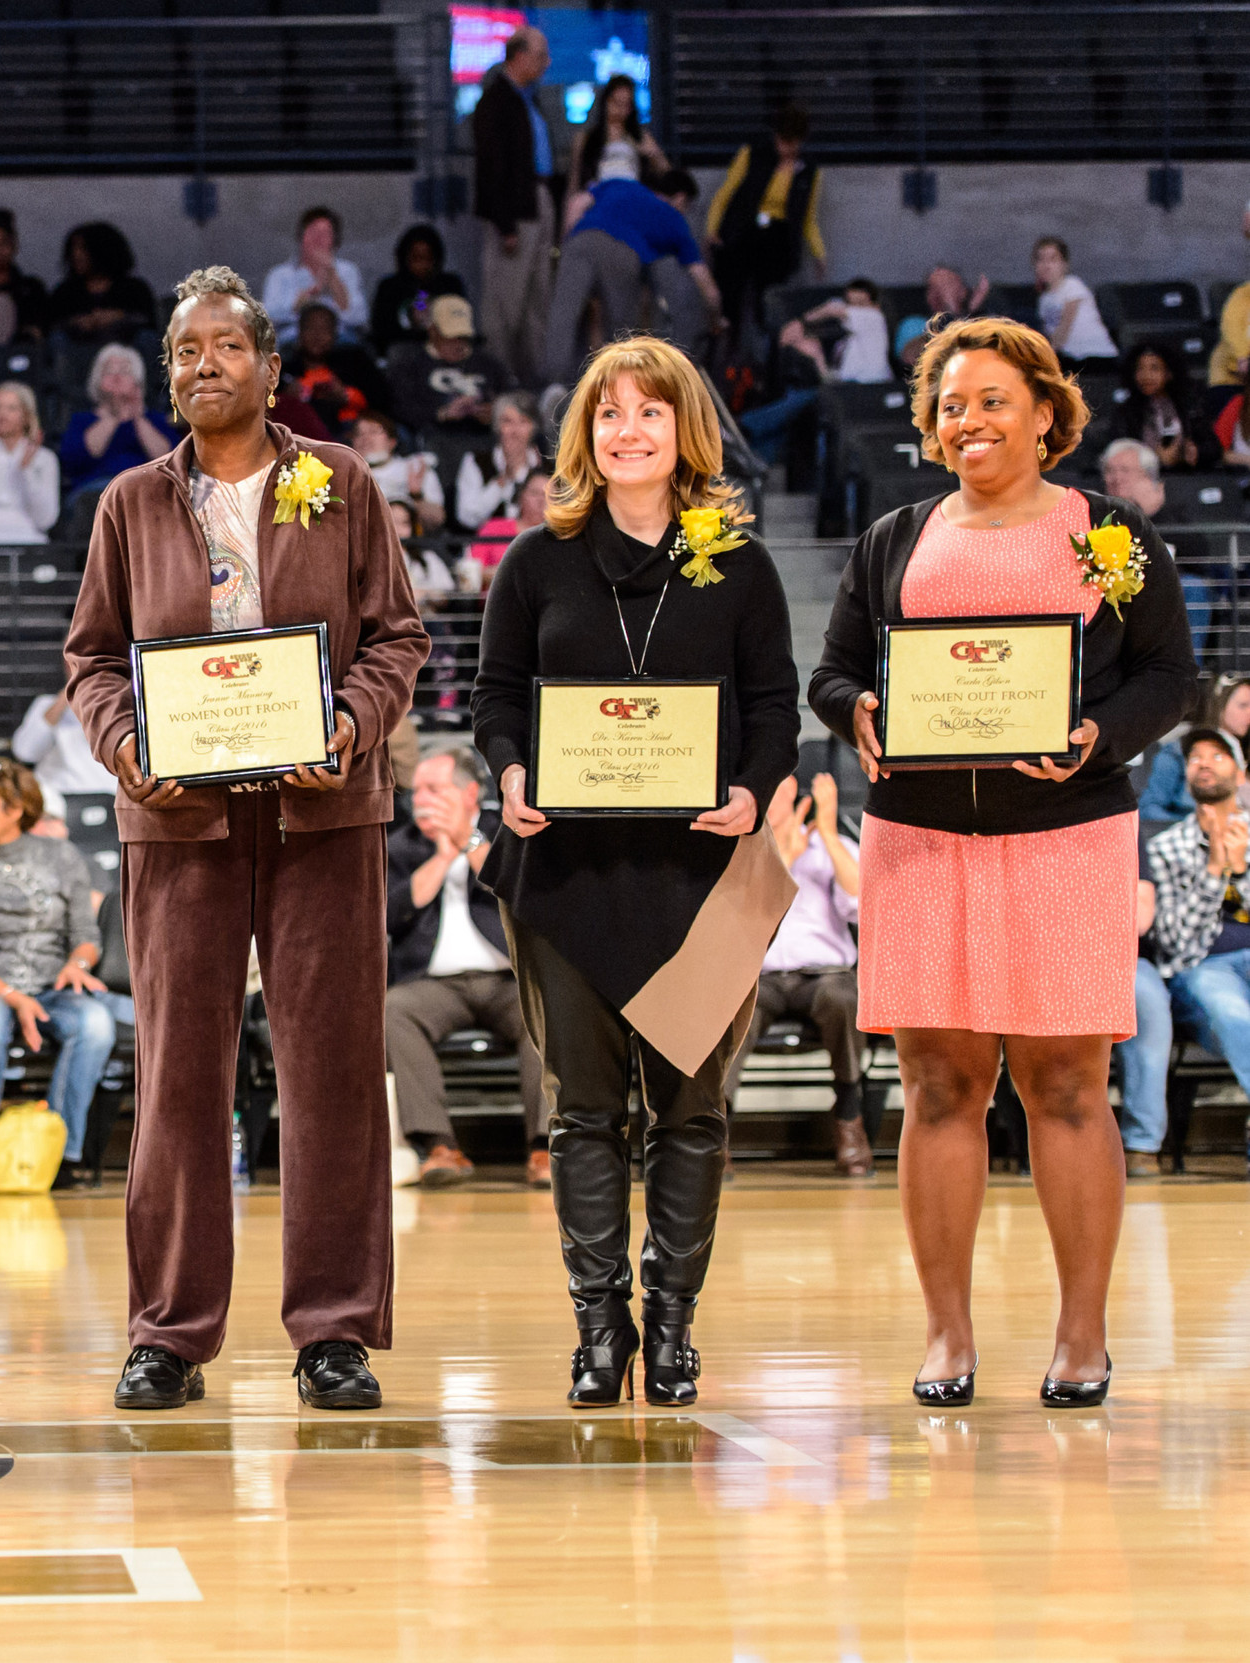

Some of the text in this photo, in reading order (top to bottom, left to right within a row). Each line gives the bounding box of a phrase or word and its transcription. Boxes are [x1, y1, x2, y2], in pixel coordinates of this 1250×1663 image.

[911, 690, 1047, 703] WOMEN OUT FRONT
[169, 700, 300, 723] WOMEN OUT FRONT
[948, 705, 972, 716] Class
[207, 722, 230, 734] Class
[612, 731, 643, 742] Karen
[561, 747, 695, 757] WOMEN OUT FRONT
[599, 760, 621, 771] Class
